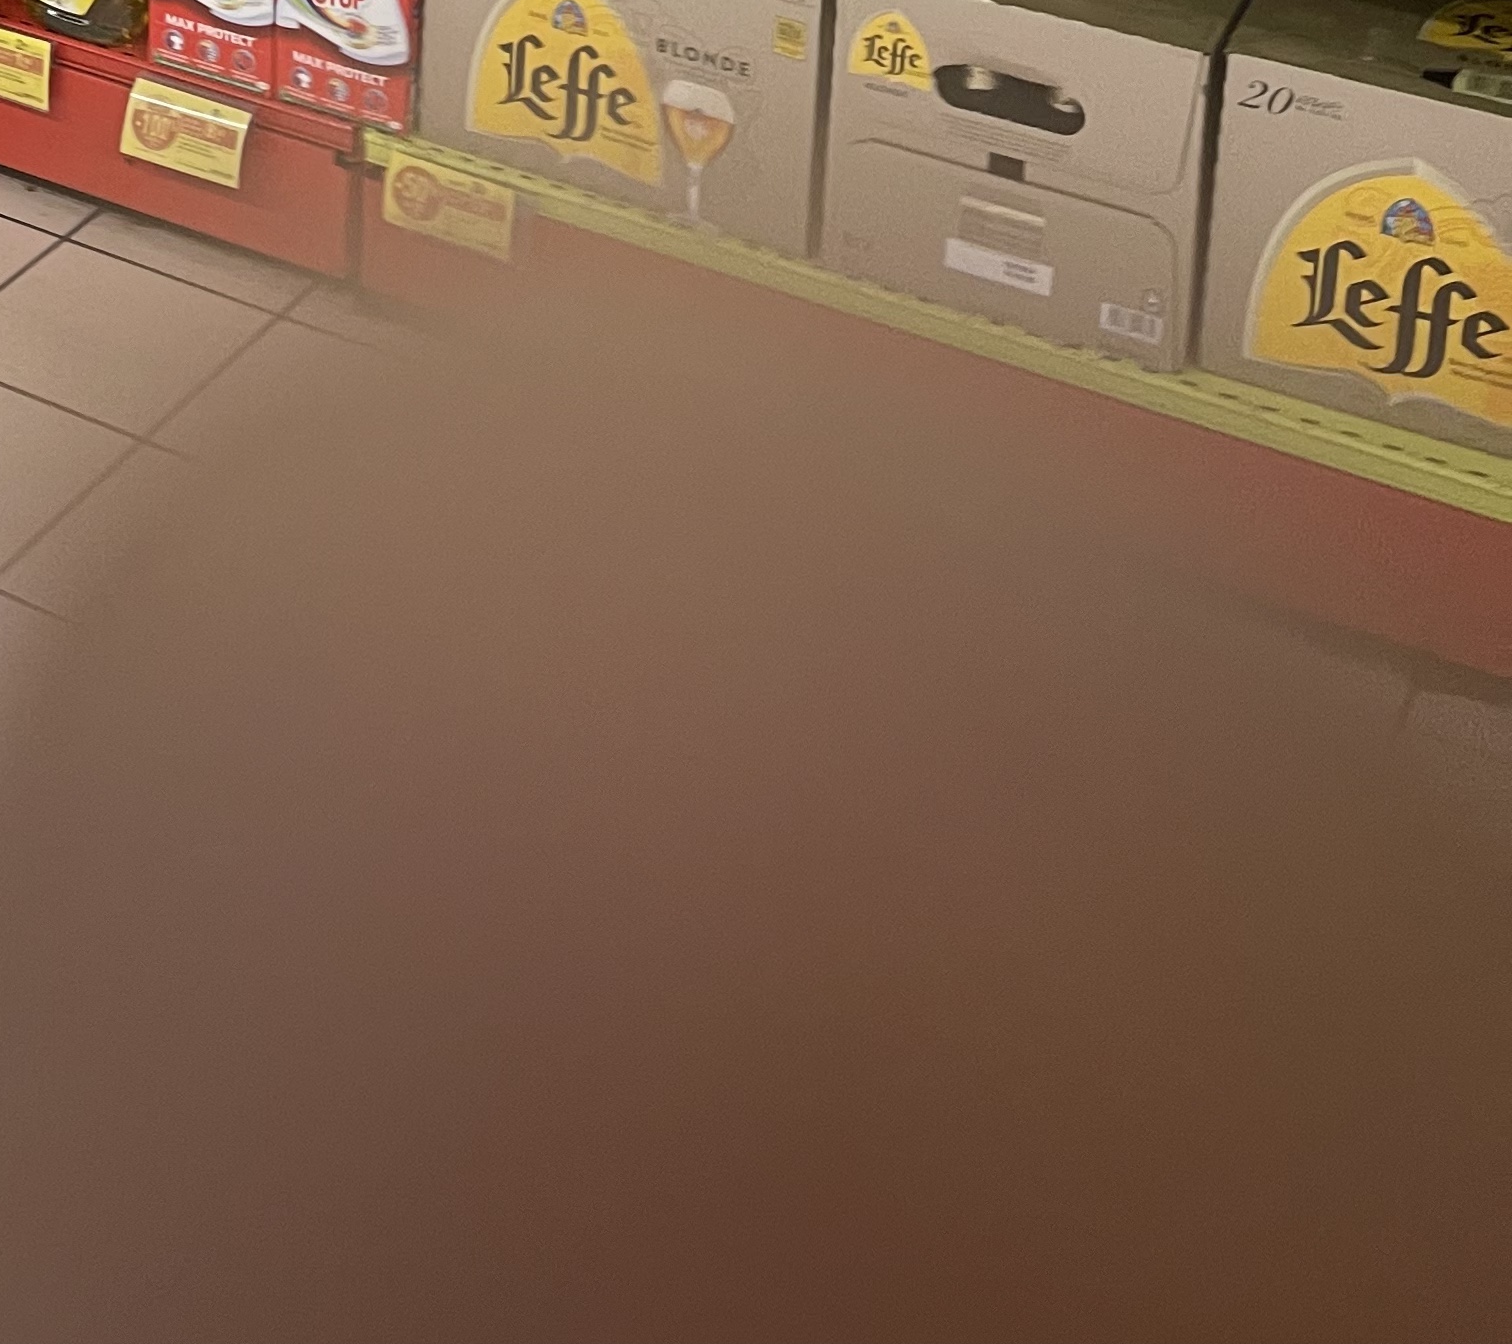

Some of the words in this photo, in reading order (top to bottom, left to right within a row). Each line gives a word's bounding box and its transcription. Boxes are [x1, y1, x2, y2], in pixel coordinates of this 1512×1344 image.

[165, 13, 194, 32] MAX
[196, 22, 256, 48] PROTECT
[293, 50, 320, 70] MAX
[324, 60, 389, 87] PROTECT
[657, 36, 751, 79] BLONDE
[863, 34, 922, 75] Leffe
[496, 33, 638, 143] Leffe
[1237, 80, 1294, 115] 20
[1290, 239, 1510, 379] Leffe
